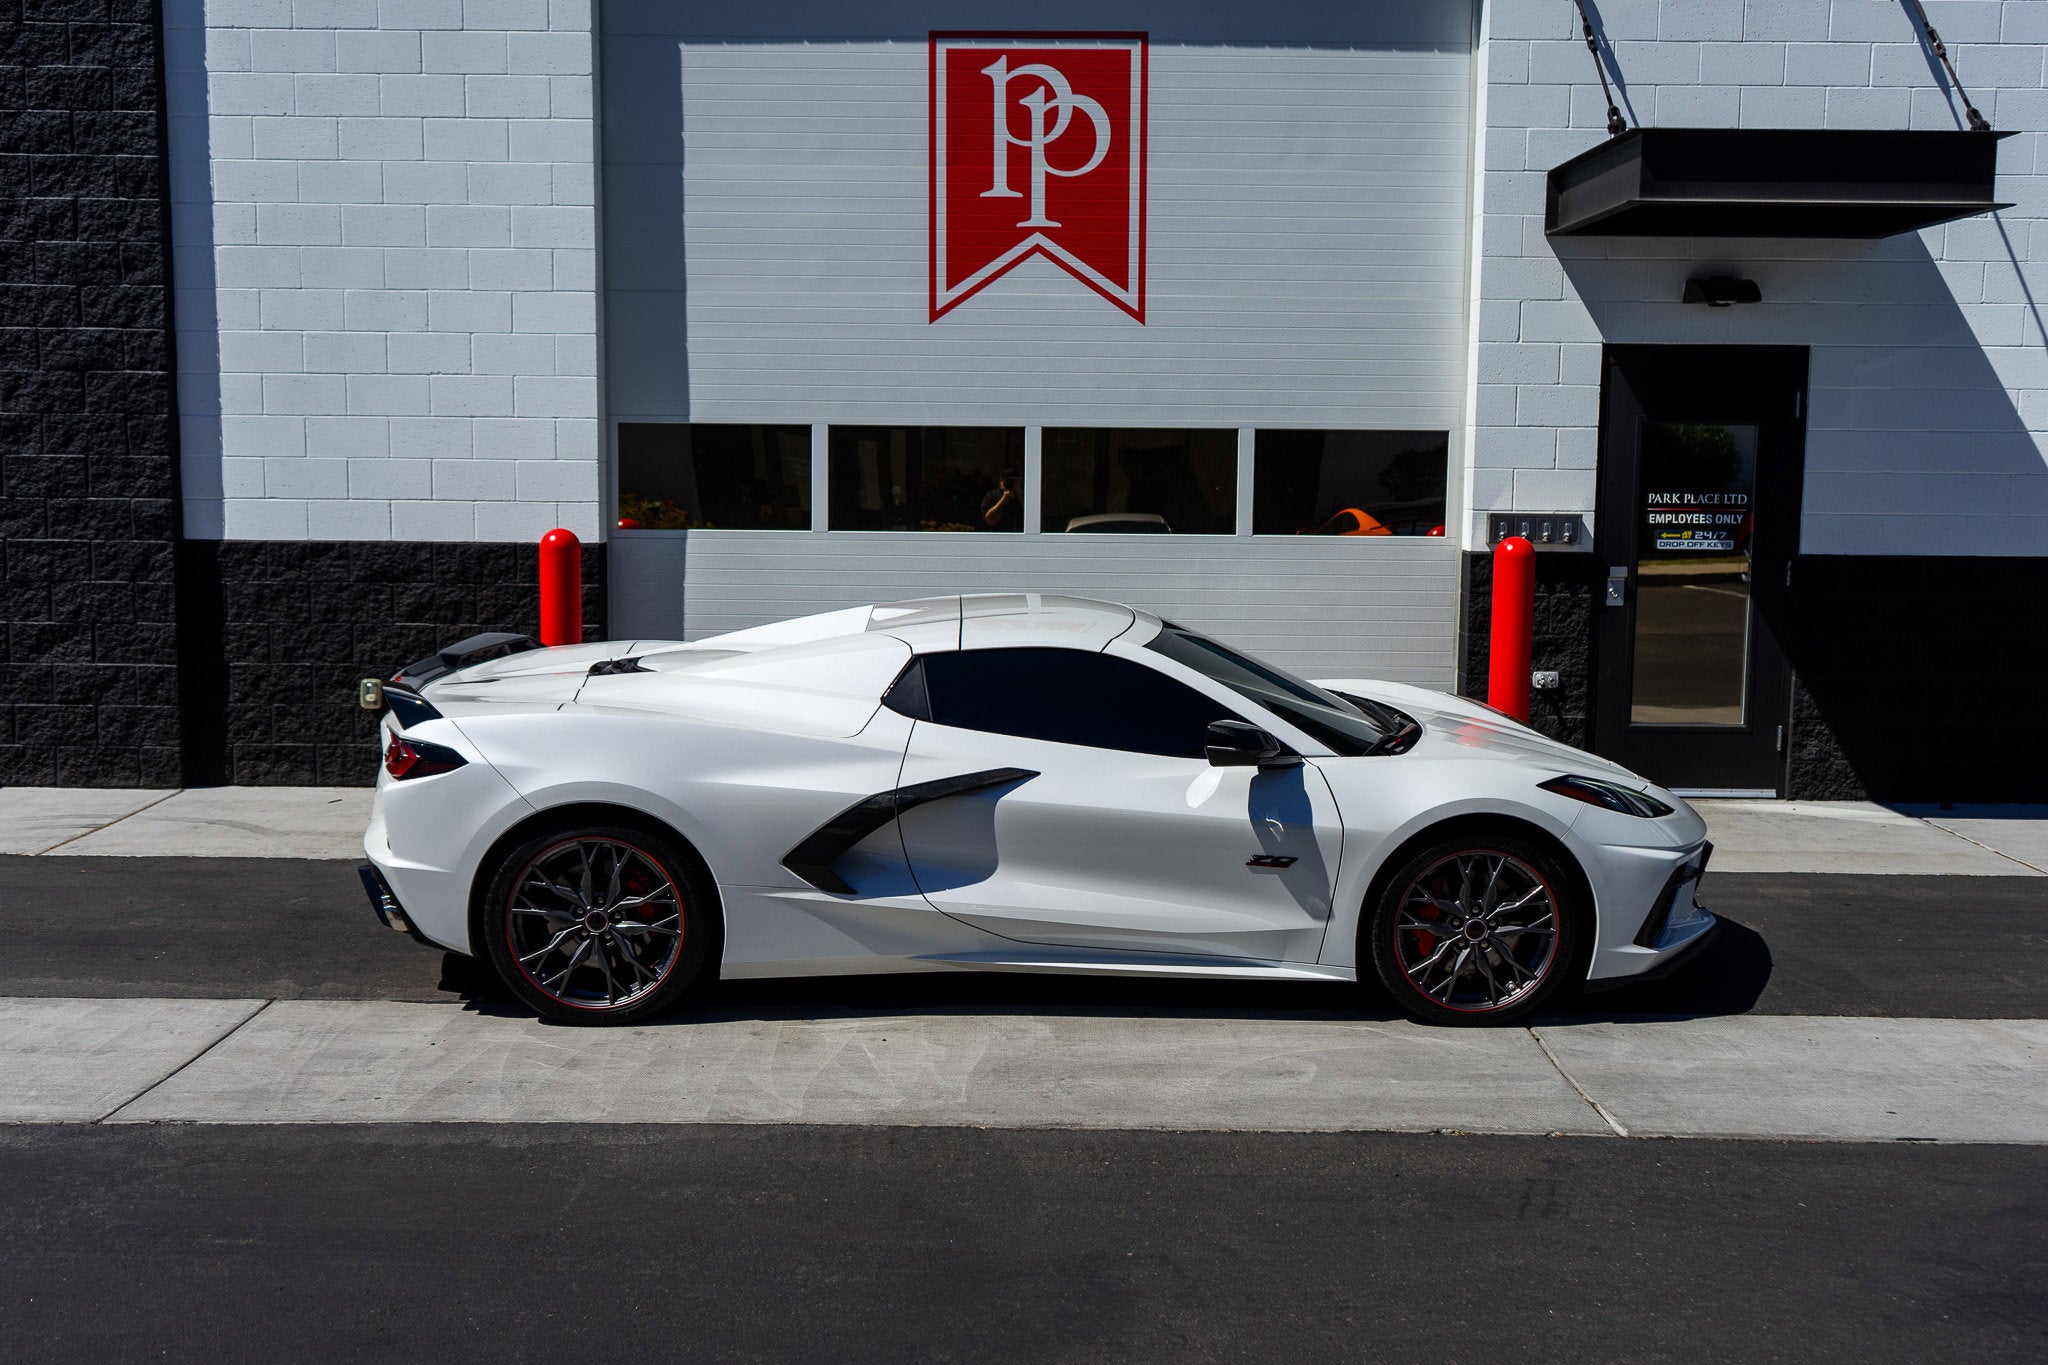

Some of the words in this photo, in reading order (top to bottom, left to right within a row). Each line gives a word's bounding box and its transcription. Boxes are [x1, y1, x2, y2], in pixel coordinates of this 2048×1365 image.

[1648, 493, 1681, 504] PARK
[1683, 493, 1721, 505] PLACE
[1723, 493, 1748, 505] LTD
[1648, 513, 1713, 524] EMPLOYEES
[1715, 514, 1744, 525] ONLY
[1694, 531, 1728, 540] 24/7
